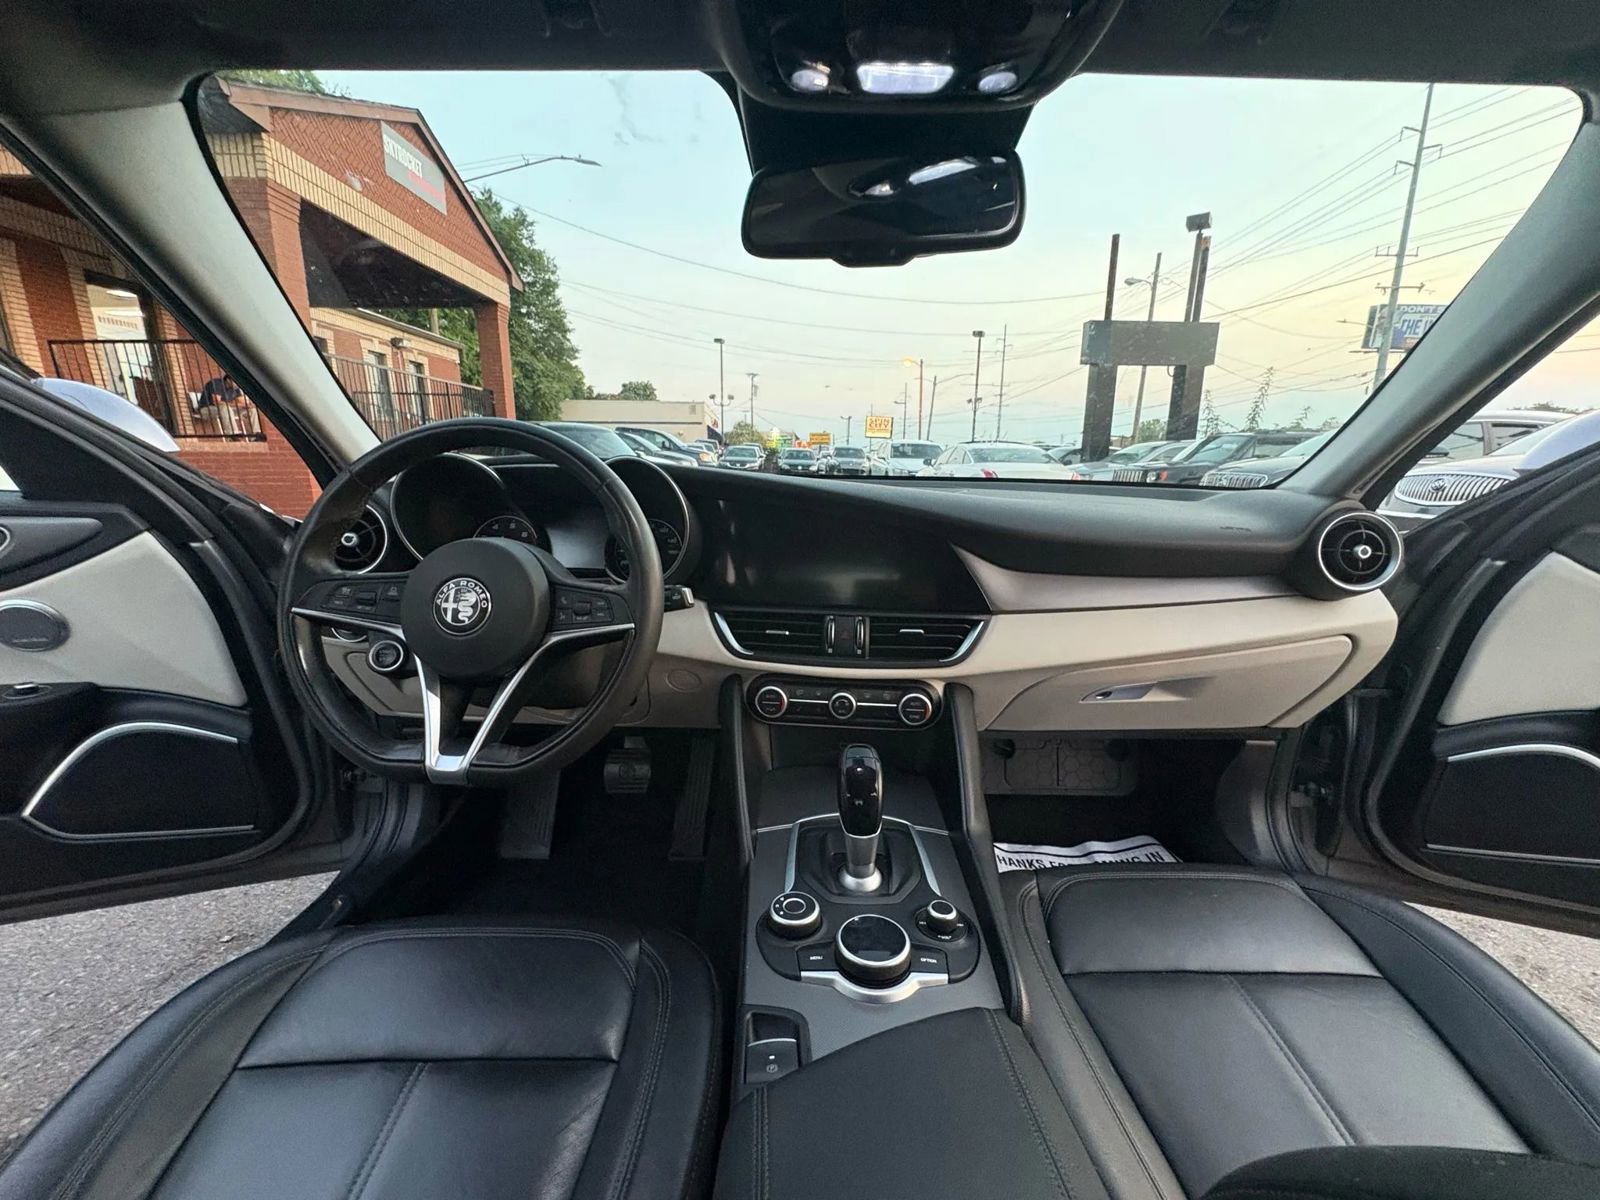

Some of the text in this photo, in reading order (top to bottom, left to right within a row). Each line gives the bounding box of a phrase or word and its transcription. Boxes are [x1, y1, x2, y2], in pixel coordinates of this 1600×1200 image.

[436, 580, 488, 608] ALFA ROMEO
[996, 854, 1045, 869] HANKS
